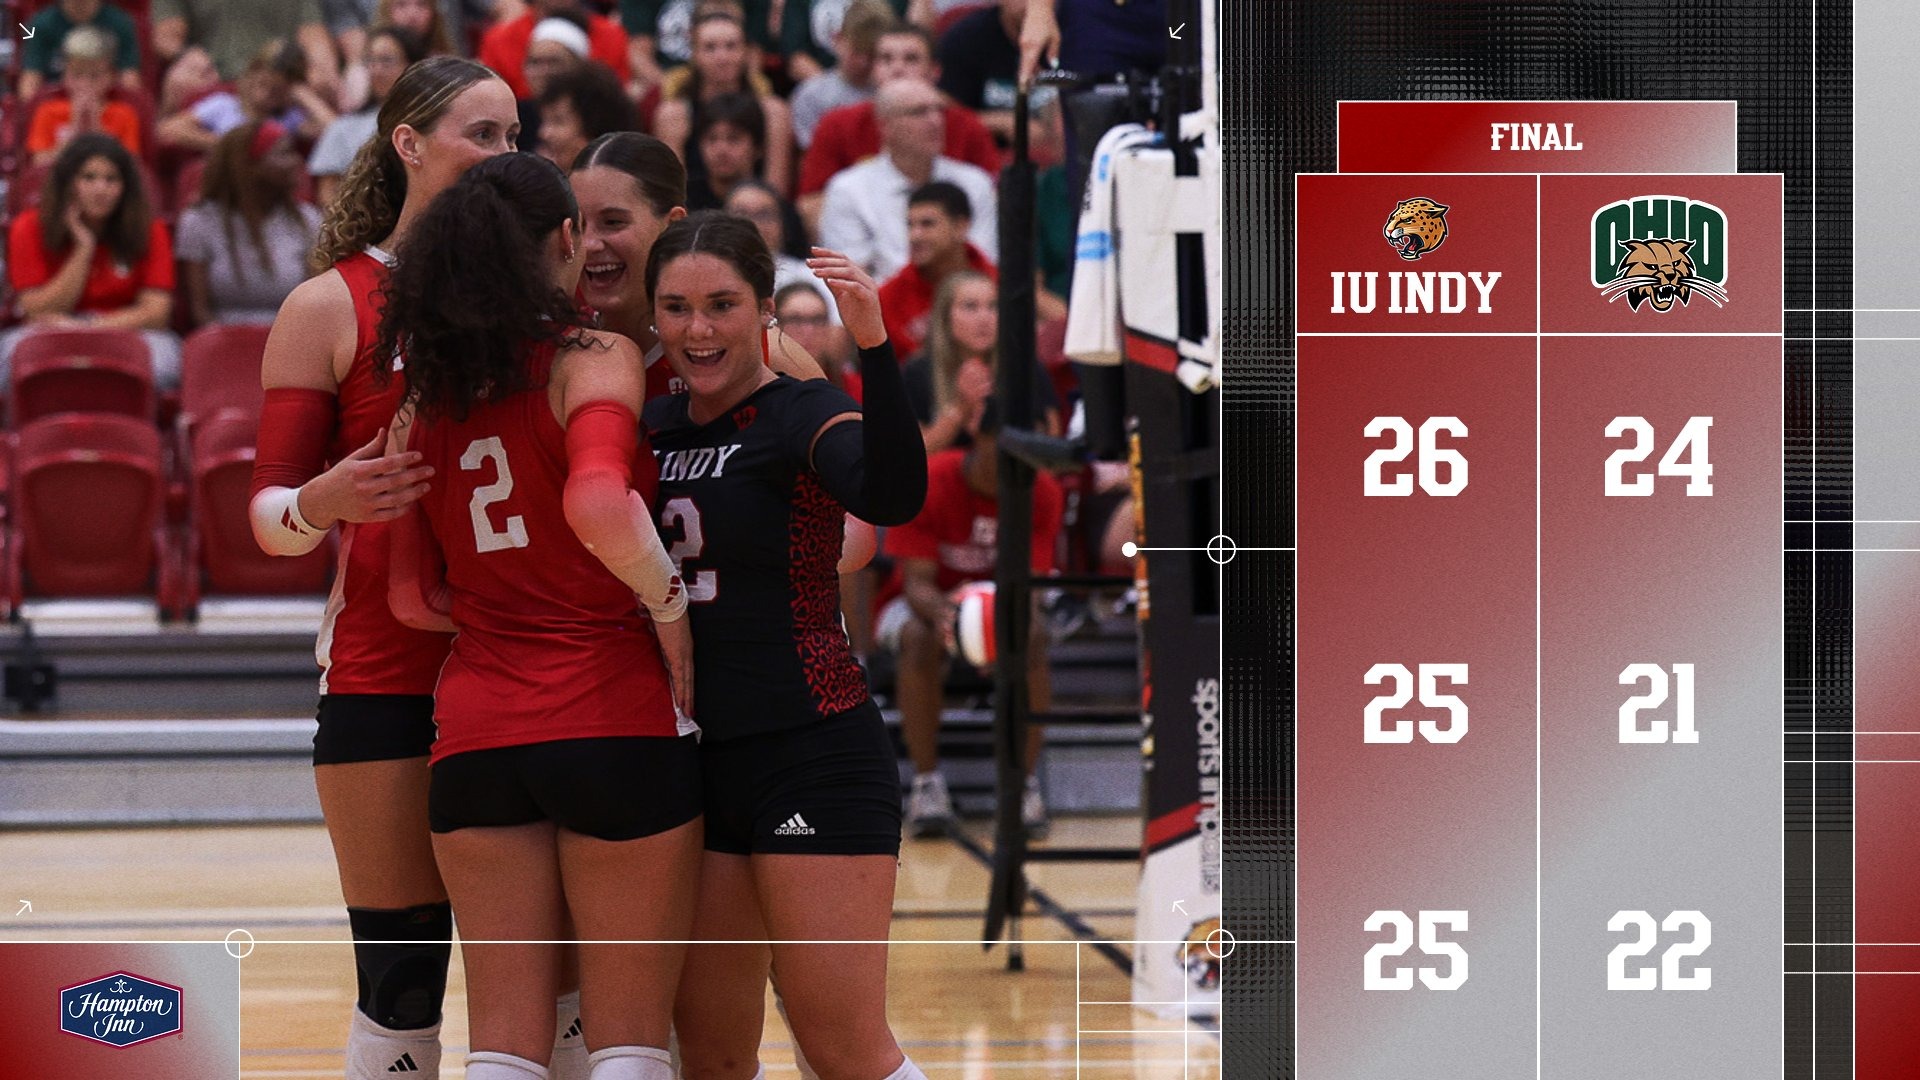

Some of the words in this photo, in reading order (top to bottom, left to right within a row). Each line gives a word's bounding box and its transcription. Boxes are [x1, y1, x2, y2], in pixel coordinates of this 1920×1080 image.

[459, 435, 530, 554] 2
[659, 444, 742, 481] INDY
[660, 497, 718, 602] 2
[773, 827, 816, 836] adidas
